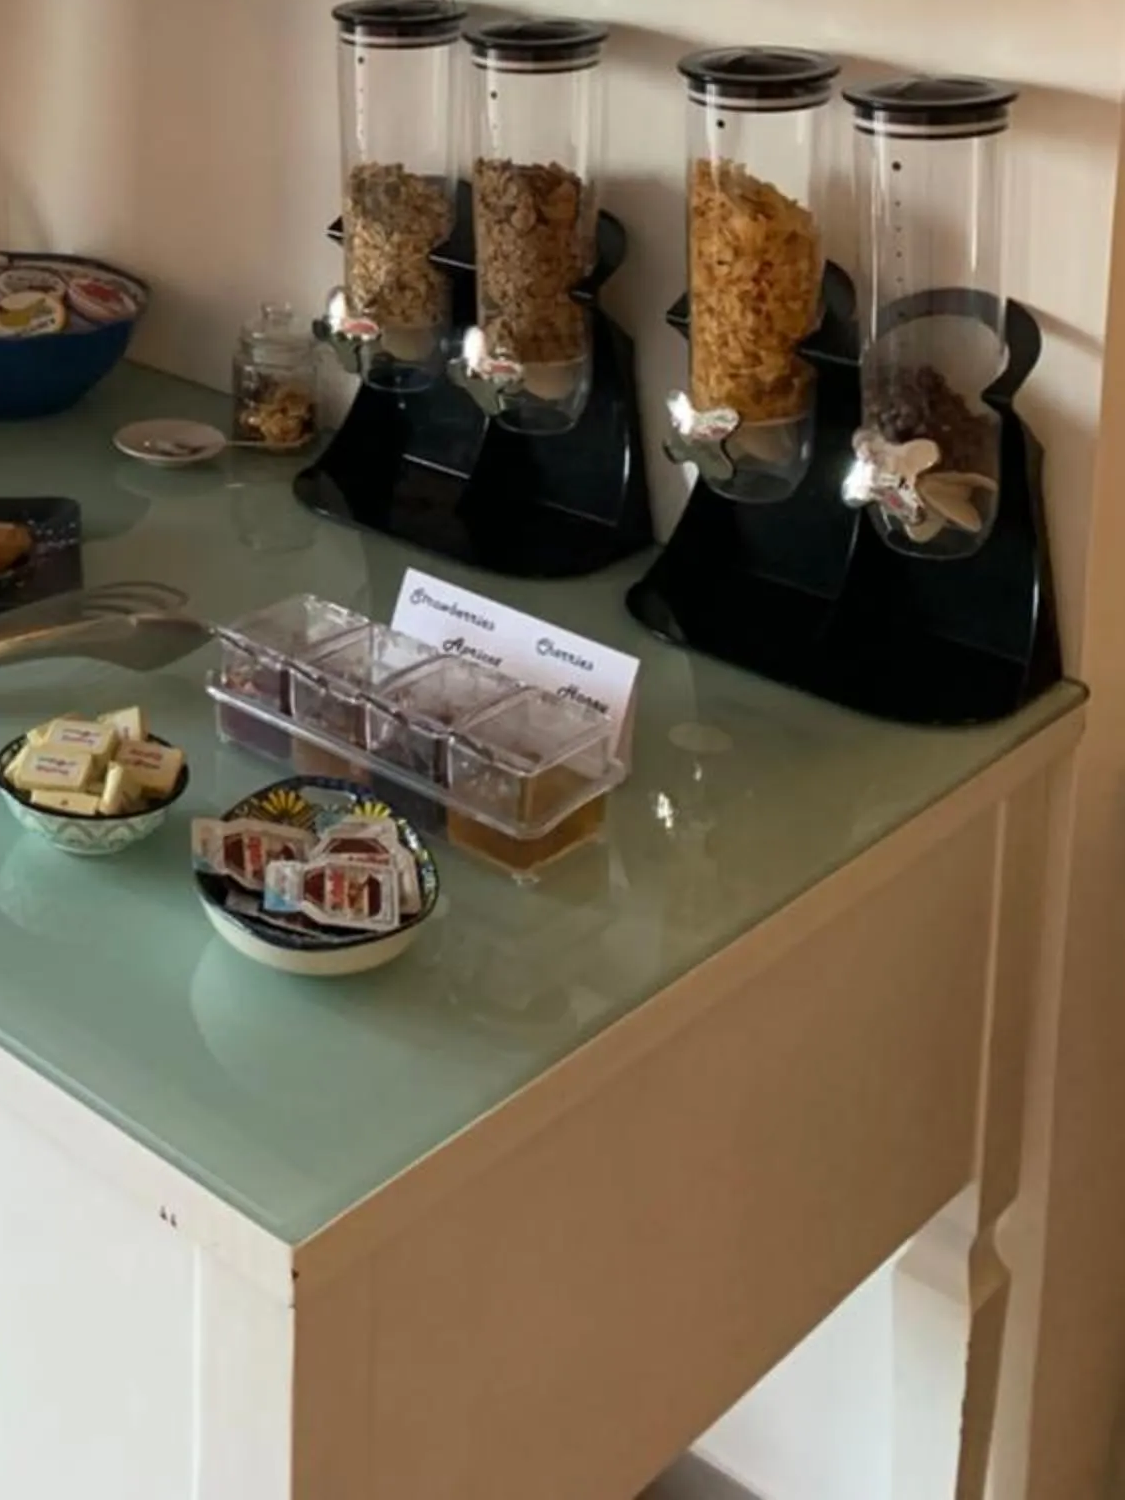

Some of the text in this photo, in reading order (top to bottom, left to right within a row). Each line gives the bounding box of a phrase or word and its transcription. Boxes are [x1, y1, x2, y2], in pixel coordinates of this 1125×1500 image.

[409, 586, 496, 633] Strawberries
[442, 636, 504, 668] Apricot
[535, 636, 595, 672] Cherries
